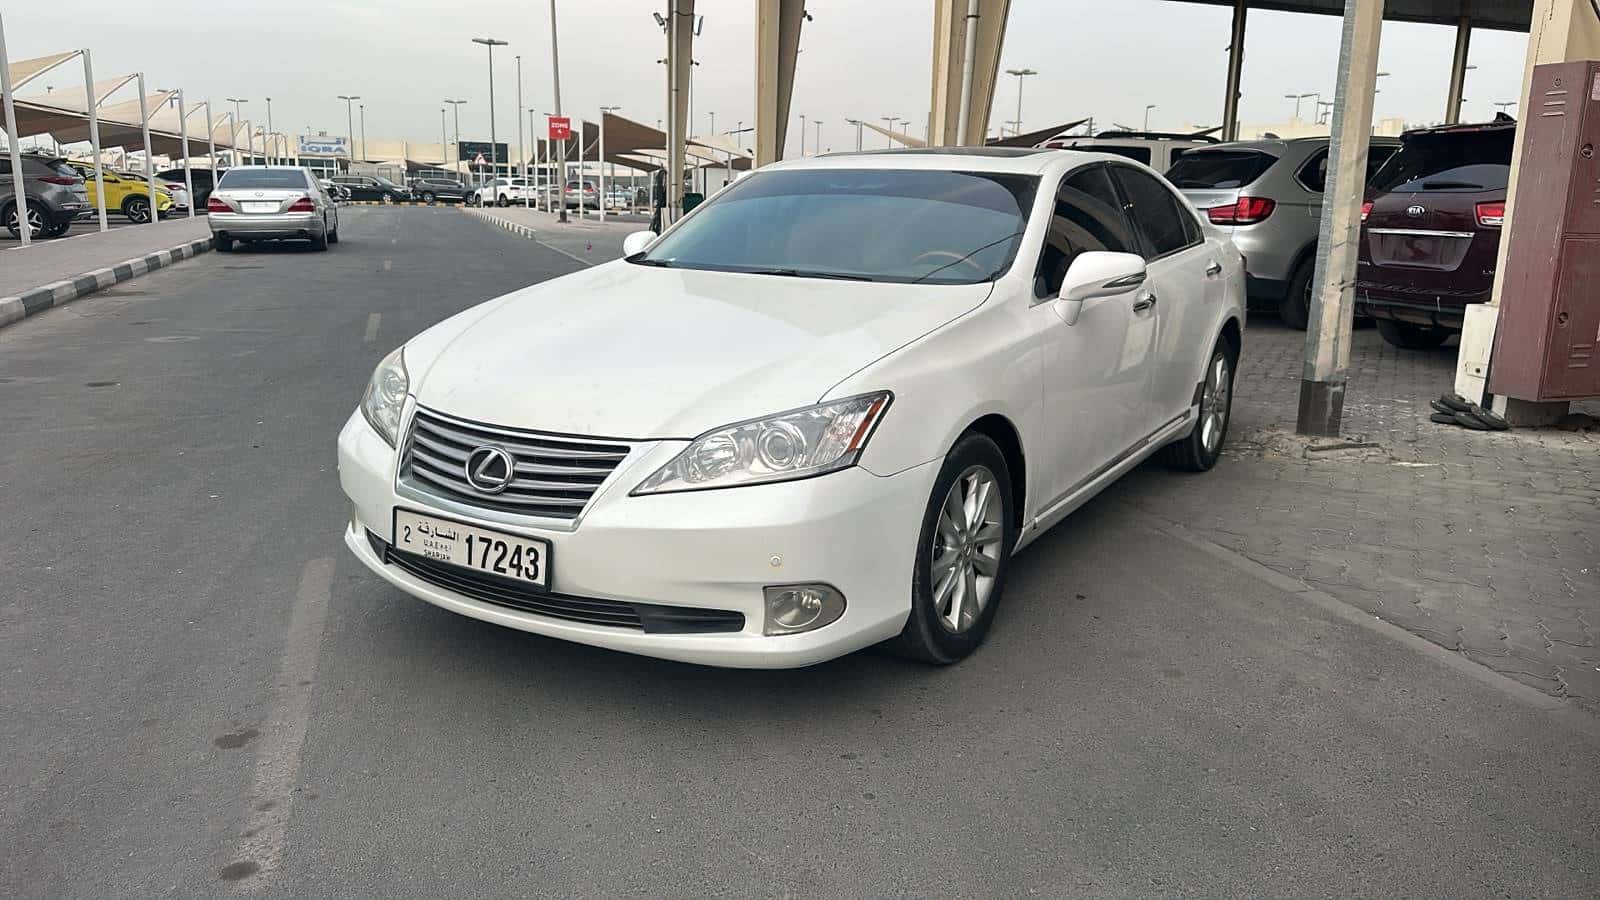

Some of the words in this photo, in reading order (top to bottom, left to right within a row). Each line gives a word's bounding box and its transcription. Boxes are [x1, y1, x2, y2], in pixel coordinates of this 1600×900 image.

[404, 525, 411, 543] 2
[417, 521, 460, 542] الشارقة
[465, 534, 540, 581] 17243
